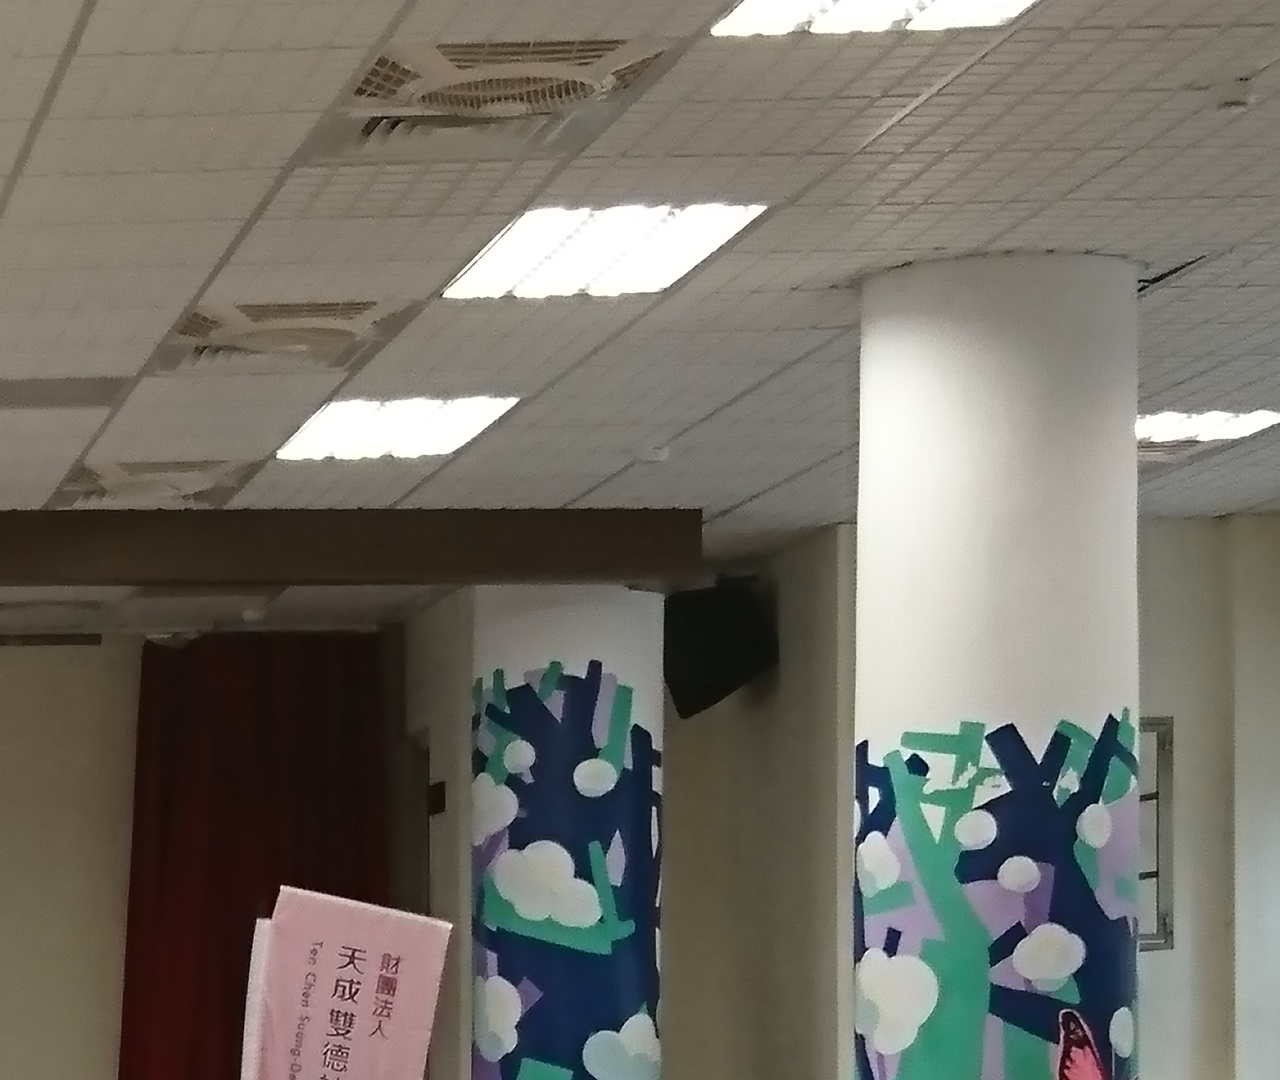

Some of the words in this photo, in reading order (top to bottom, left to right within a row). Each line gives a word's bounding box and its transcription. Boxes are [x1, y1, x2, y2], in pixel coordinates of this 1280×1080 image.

[301, 971, 317, 1008] Chen
[368, 953, 402, 1040] 財團法人
